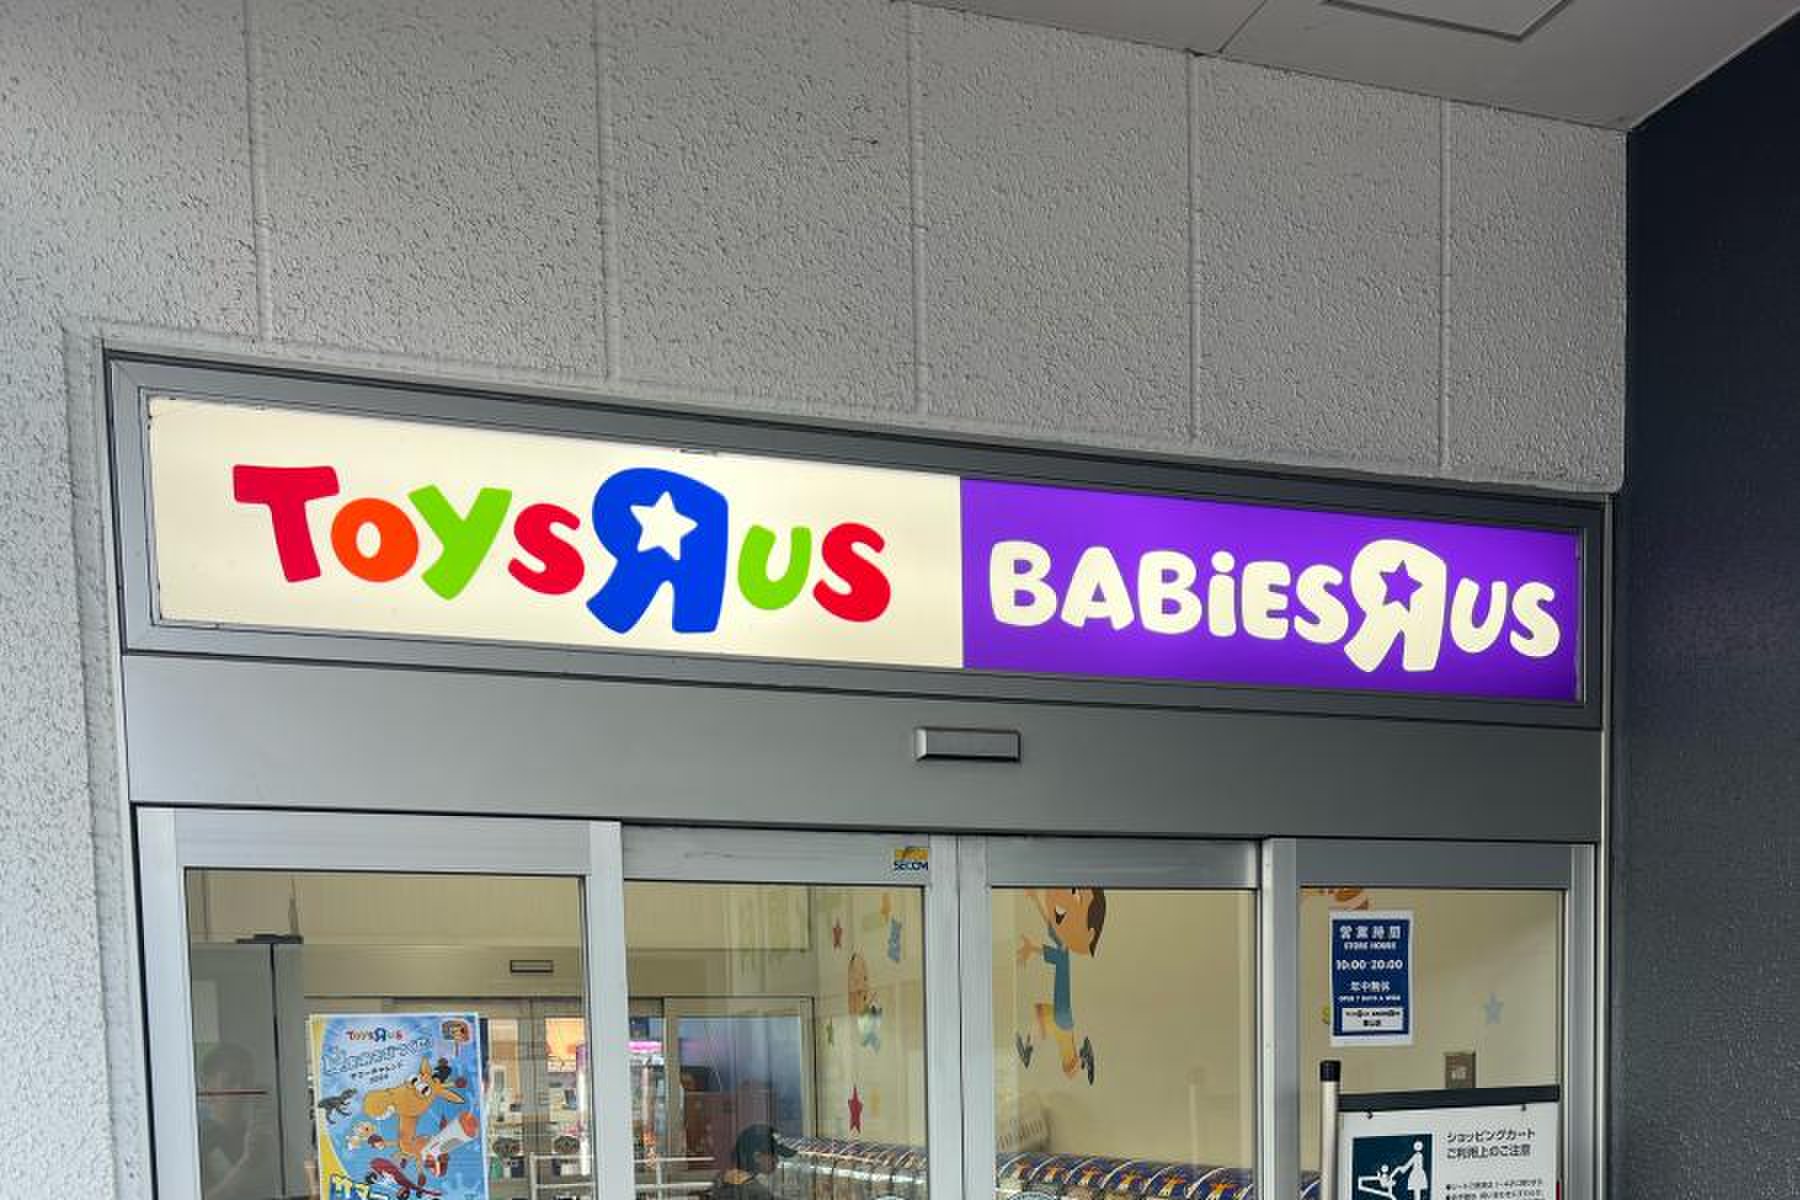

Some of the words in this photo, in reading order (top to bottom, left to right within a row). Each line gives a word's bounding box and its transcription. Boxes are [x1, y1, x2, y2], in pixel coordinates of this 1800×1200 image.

[1446, 1127, 1536, 1143] ショッピングカート
[1446, 1143, 1532, 1159] ご利用上のご注意
